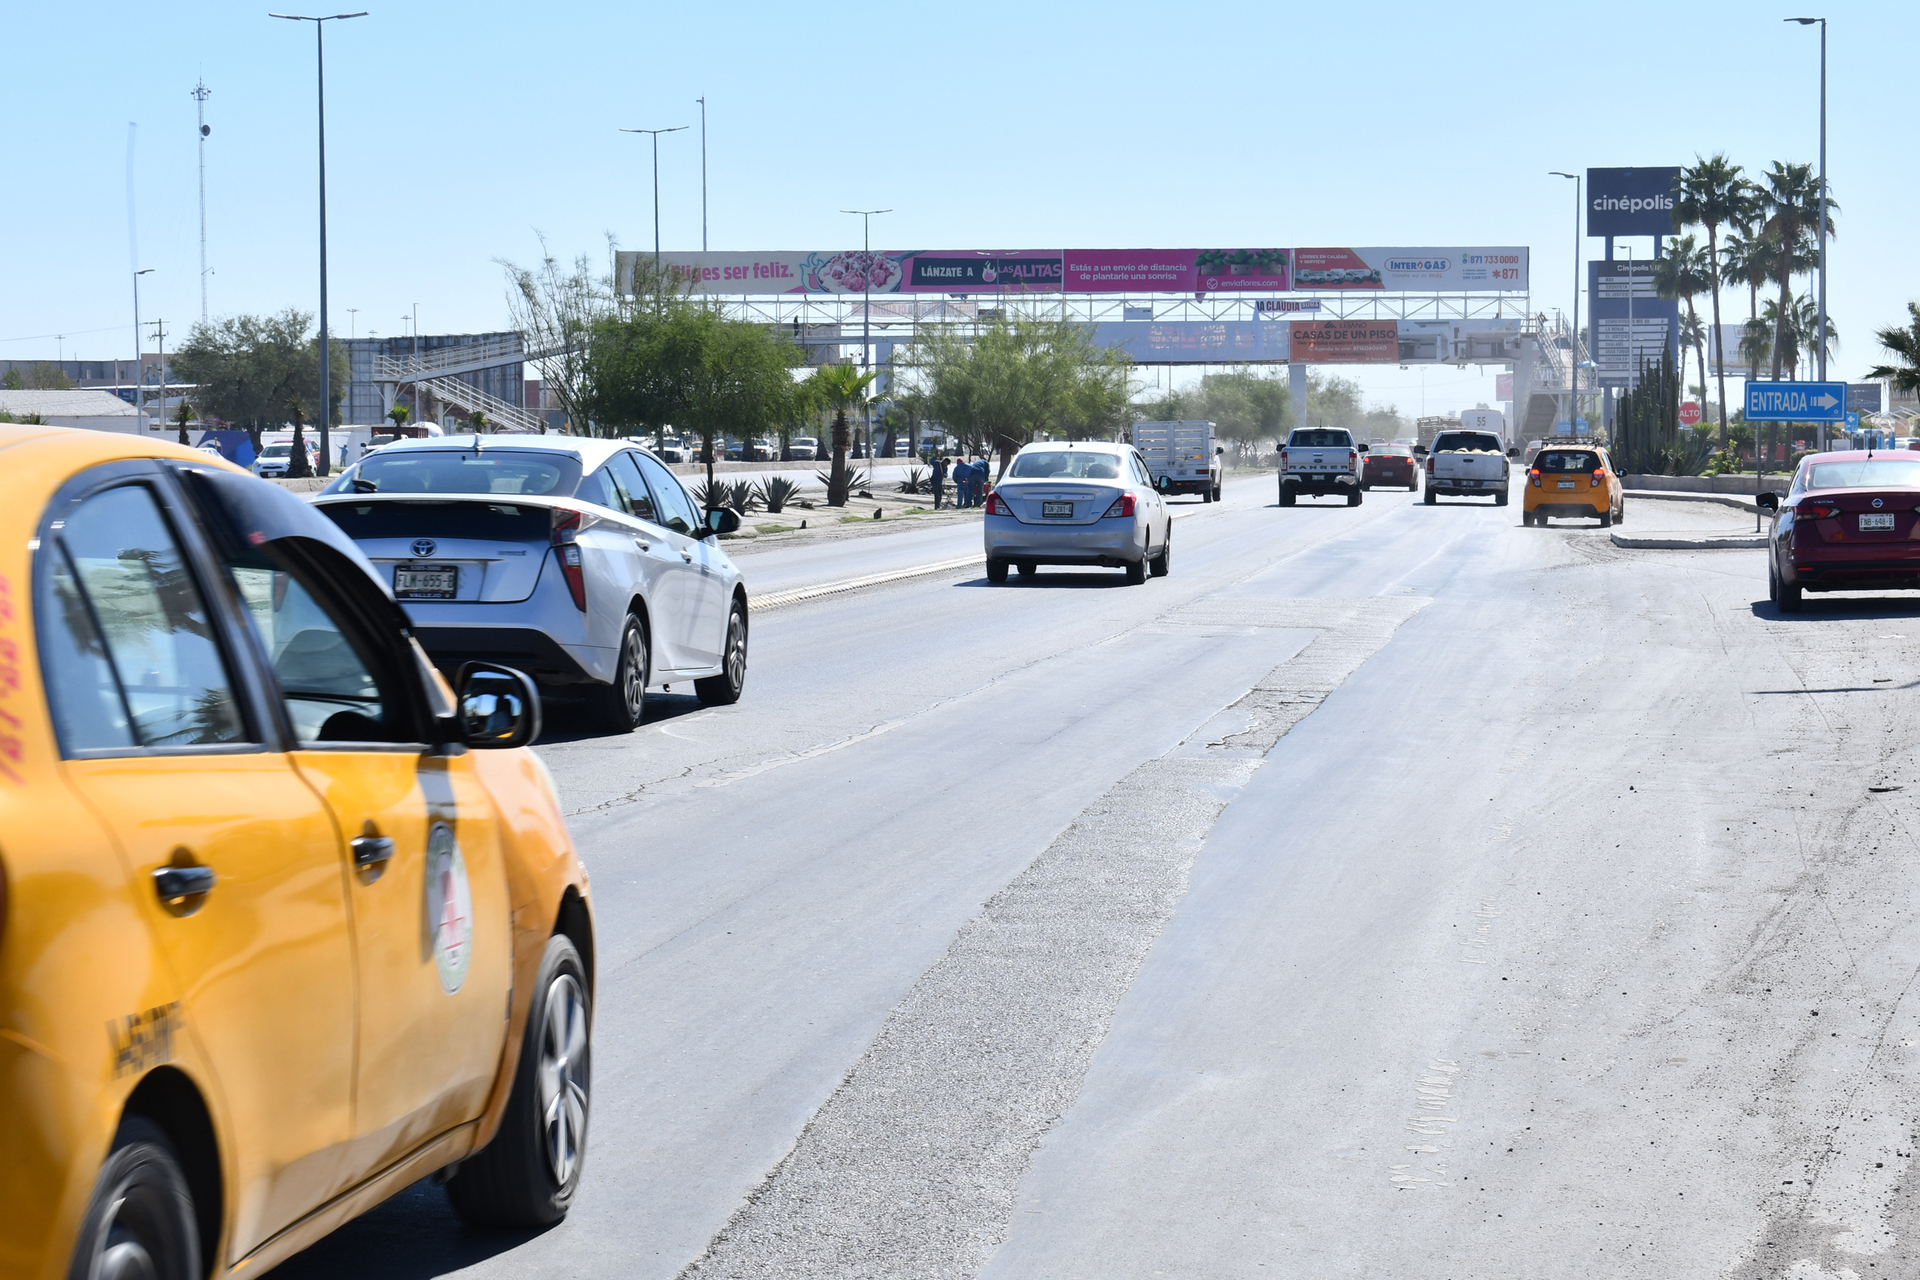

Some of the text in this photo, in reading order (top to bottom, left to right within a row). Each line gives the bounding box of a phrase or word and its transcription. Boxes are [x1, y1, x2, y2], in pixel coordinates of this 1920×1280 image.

[1593, 194, 1673, 213] cinépolis
[1470, 256, 1519, 264] 871 733 0000
[724, 266, 749, 280] ser
[753, 262, 794, 279] feliz.
[921, 265, 974, 277] LÁNZATE A
[1013, 264, 1062, 278] ALITAS
[1070, 264, 1092, 272] Estás
[1138, 263, 1148, 271] de
[1150, 263, 1187, 272] distancia
[1080, 272, 1091, 280] de
[1093, 272, 1129, 282] plantarle
[1221, 279, 1278, 287] enviaflores.com
[1266, 301, 1300, 311] CLAUDIA
[1294, 330, 1395, 340] CASAS DE UN PISO
[1751, 392, 1807, 412] ENTRADA
[1477, 416, 1486, 426] 55
